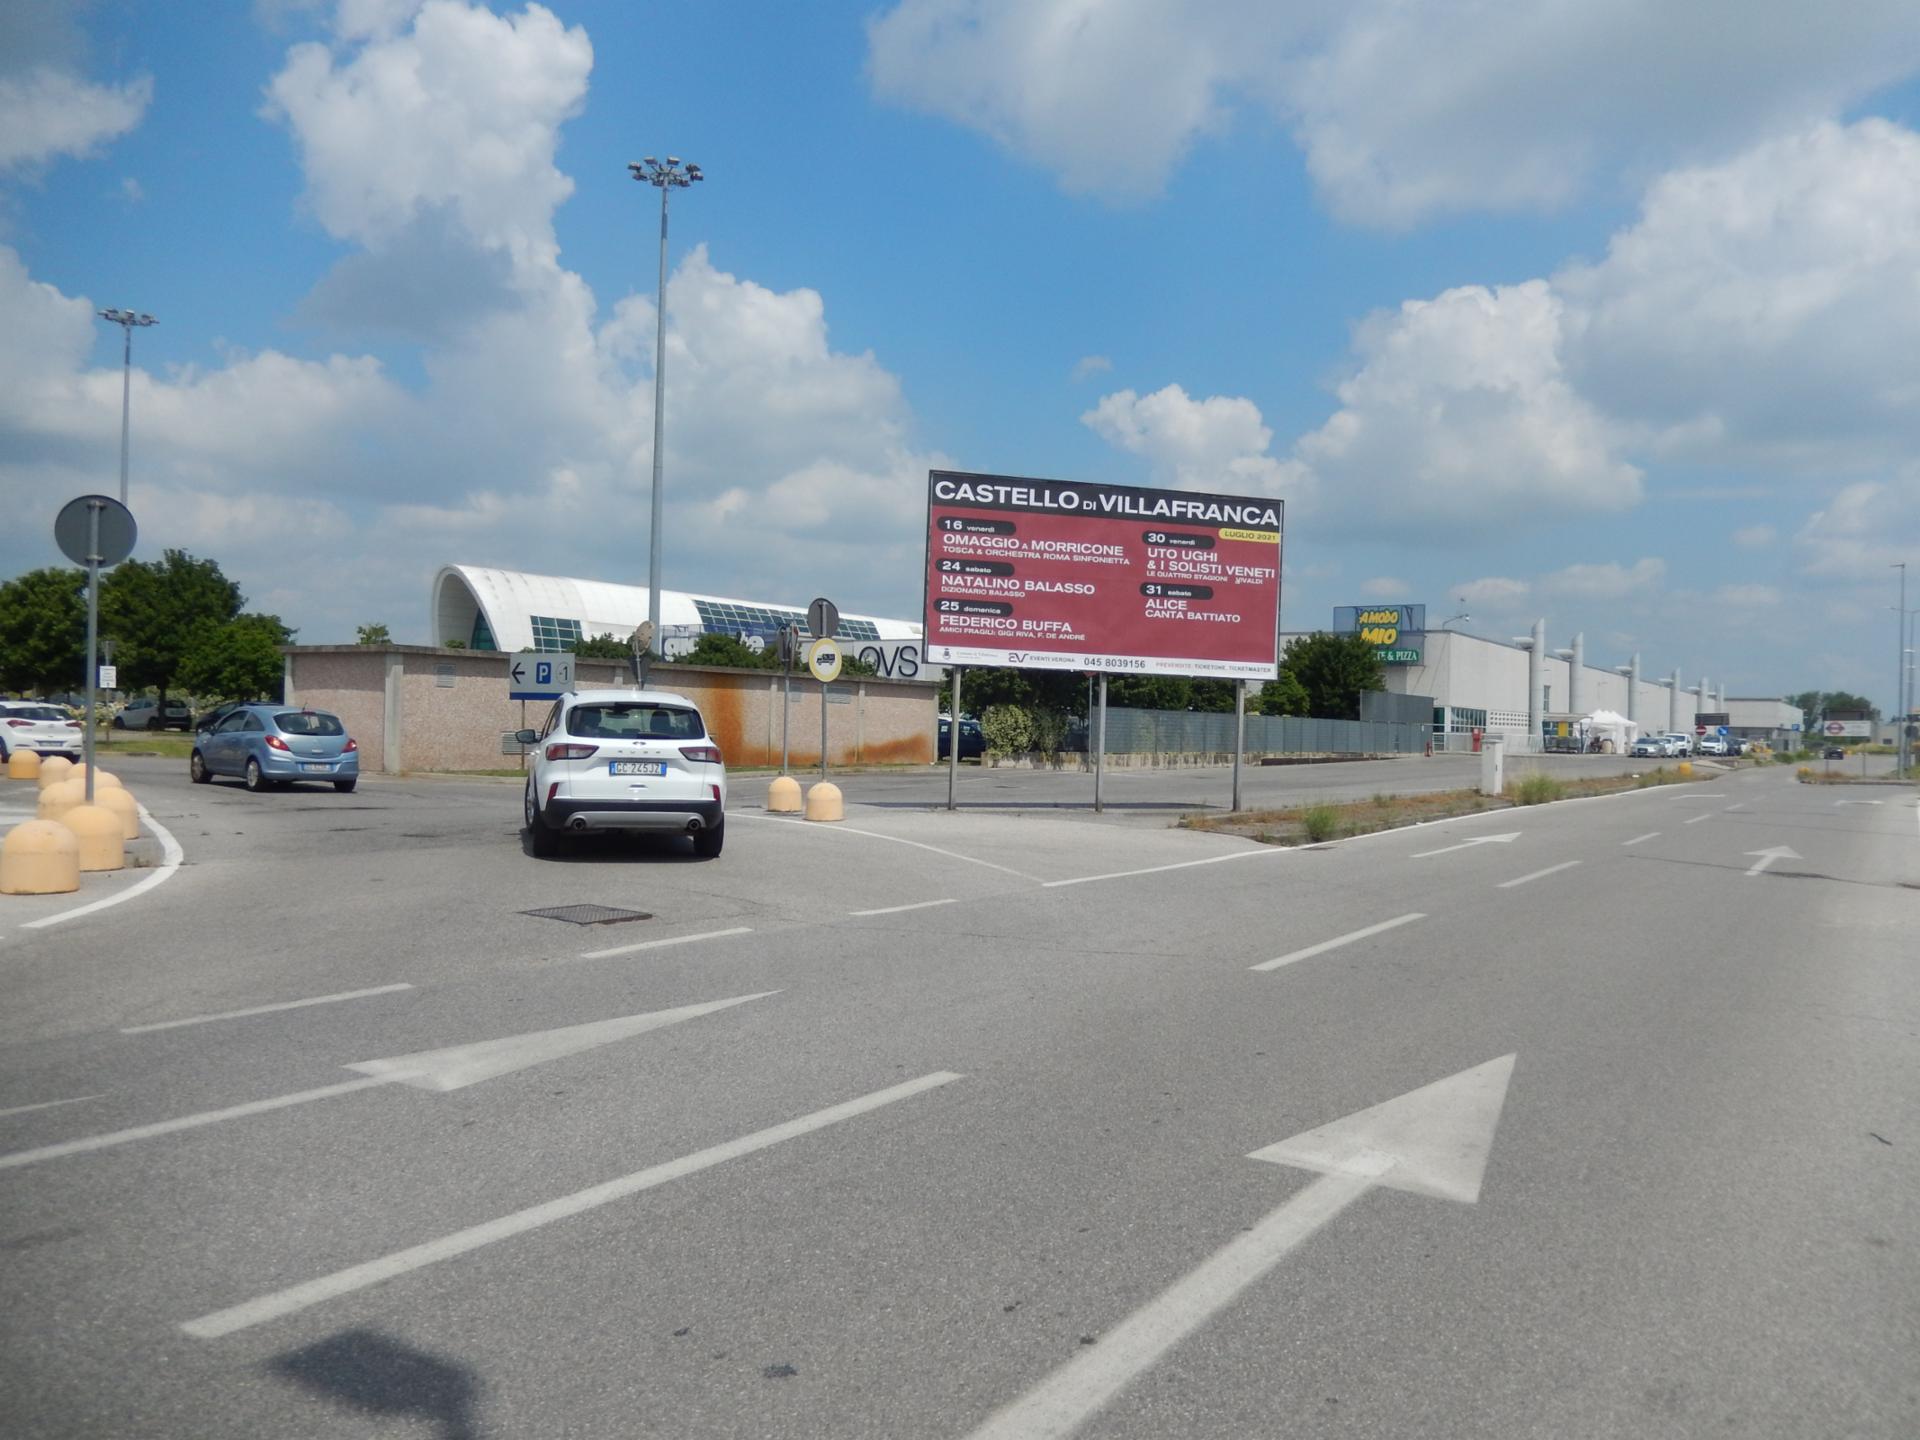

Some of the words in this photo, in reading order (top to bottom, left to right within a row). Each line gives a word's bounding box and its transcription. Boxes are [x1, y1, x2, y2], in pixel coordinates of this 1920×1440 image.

[935, 480, 1079, 509] CASTELLO
[1083, 501, 1097, 510] DI
[1099, 494, 1278, 526] VILLAFRANCA
[944, 520, 962, 530] 16
[1148, 534, 1166, 543] 30
[1224, 530, 1254, 540] LUGLIO
[1256, 533, 1276, 541] 2021
[944, 534, 1020, 549] OMAGGIO
[1032, 540, 1124, 556] MORRICONE
[943, 546, 974, 554] TOSCA
[985, 549, 1040, 559] ORCHESTRA
[1043, 553, 1070, 561] ROMA
[1073, 554, 1130, 565] SINFONIETTA
[1148, 548, 1178, 559] UTO
[1182, 550, 1218, 562] UGHI
[942, 560, 960, 571] 24
[1147, 560, 1156, 570] &
[1160, 562, 1164, 570] I
[1168, 562, 1222, 574] SOLISTI
[1226, 566, 1275, 578] VENETI
[941, 586, 987, 595] DIZIONARIO
[942, 575, 1020, 590] NATALINO
[1025, 580, 1095, 595] BALASSO
[1146, 586, 1162, 594] 31
[940, 601, 959, 611] 25
[1145, 599, 1188, 610] ALICE
[1145, 610, 1184, 619] CANTA
[1187, 612, 1241, 622] BATTIATO
[940, 615, 1017, 630] FEDERICO
[1022, 620, 1072, 632] BUFFA
[1360, 627, 1397, 644] MIO
[1396, 651, 1417, 660] PIZZA
[1084, 658, 1102, 666] 045
[1105, 659, 1146, 668] 8039156
[539, 664, 548, 681] P
